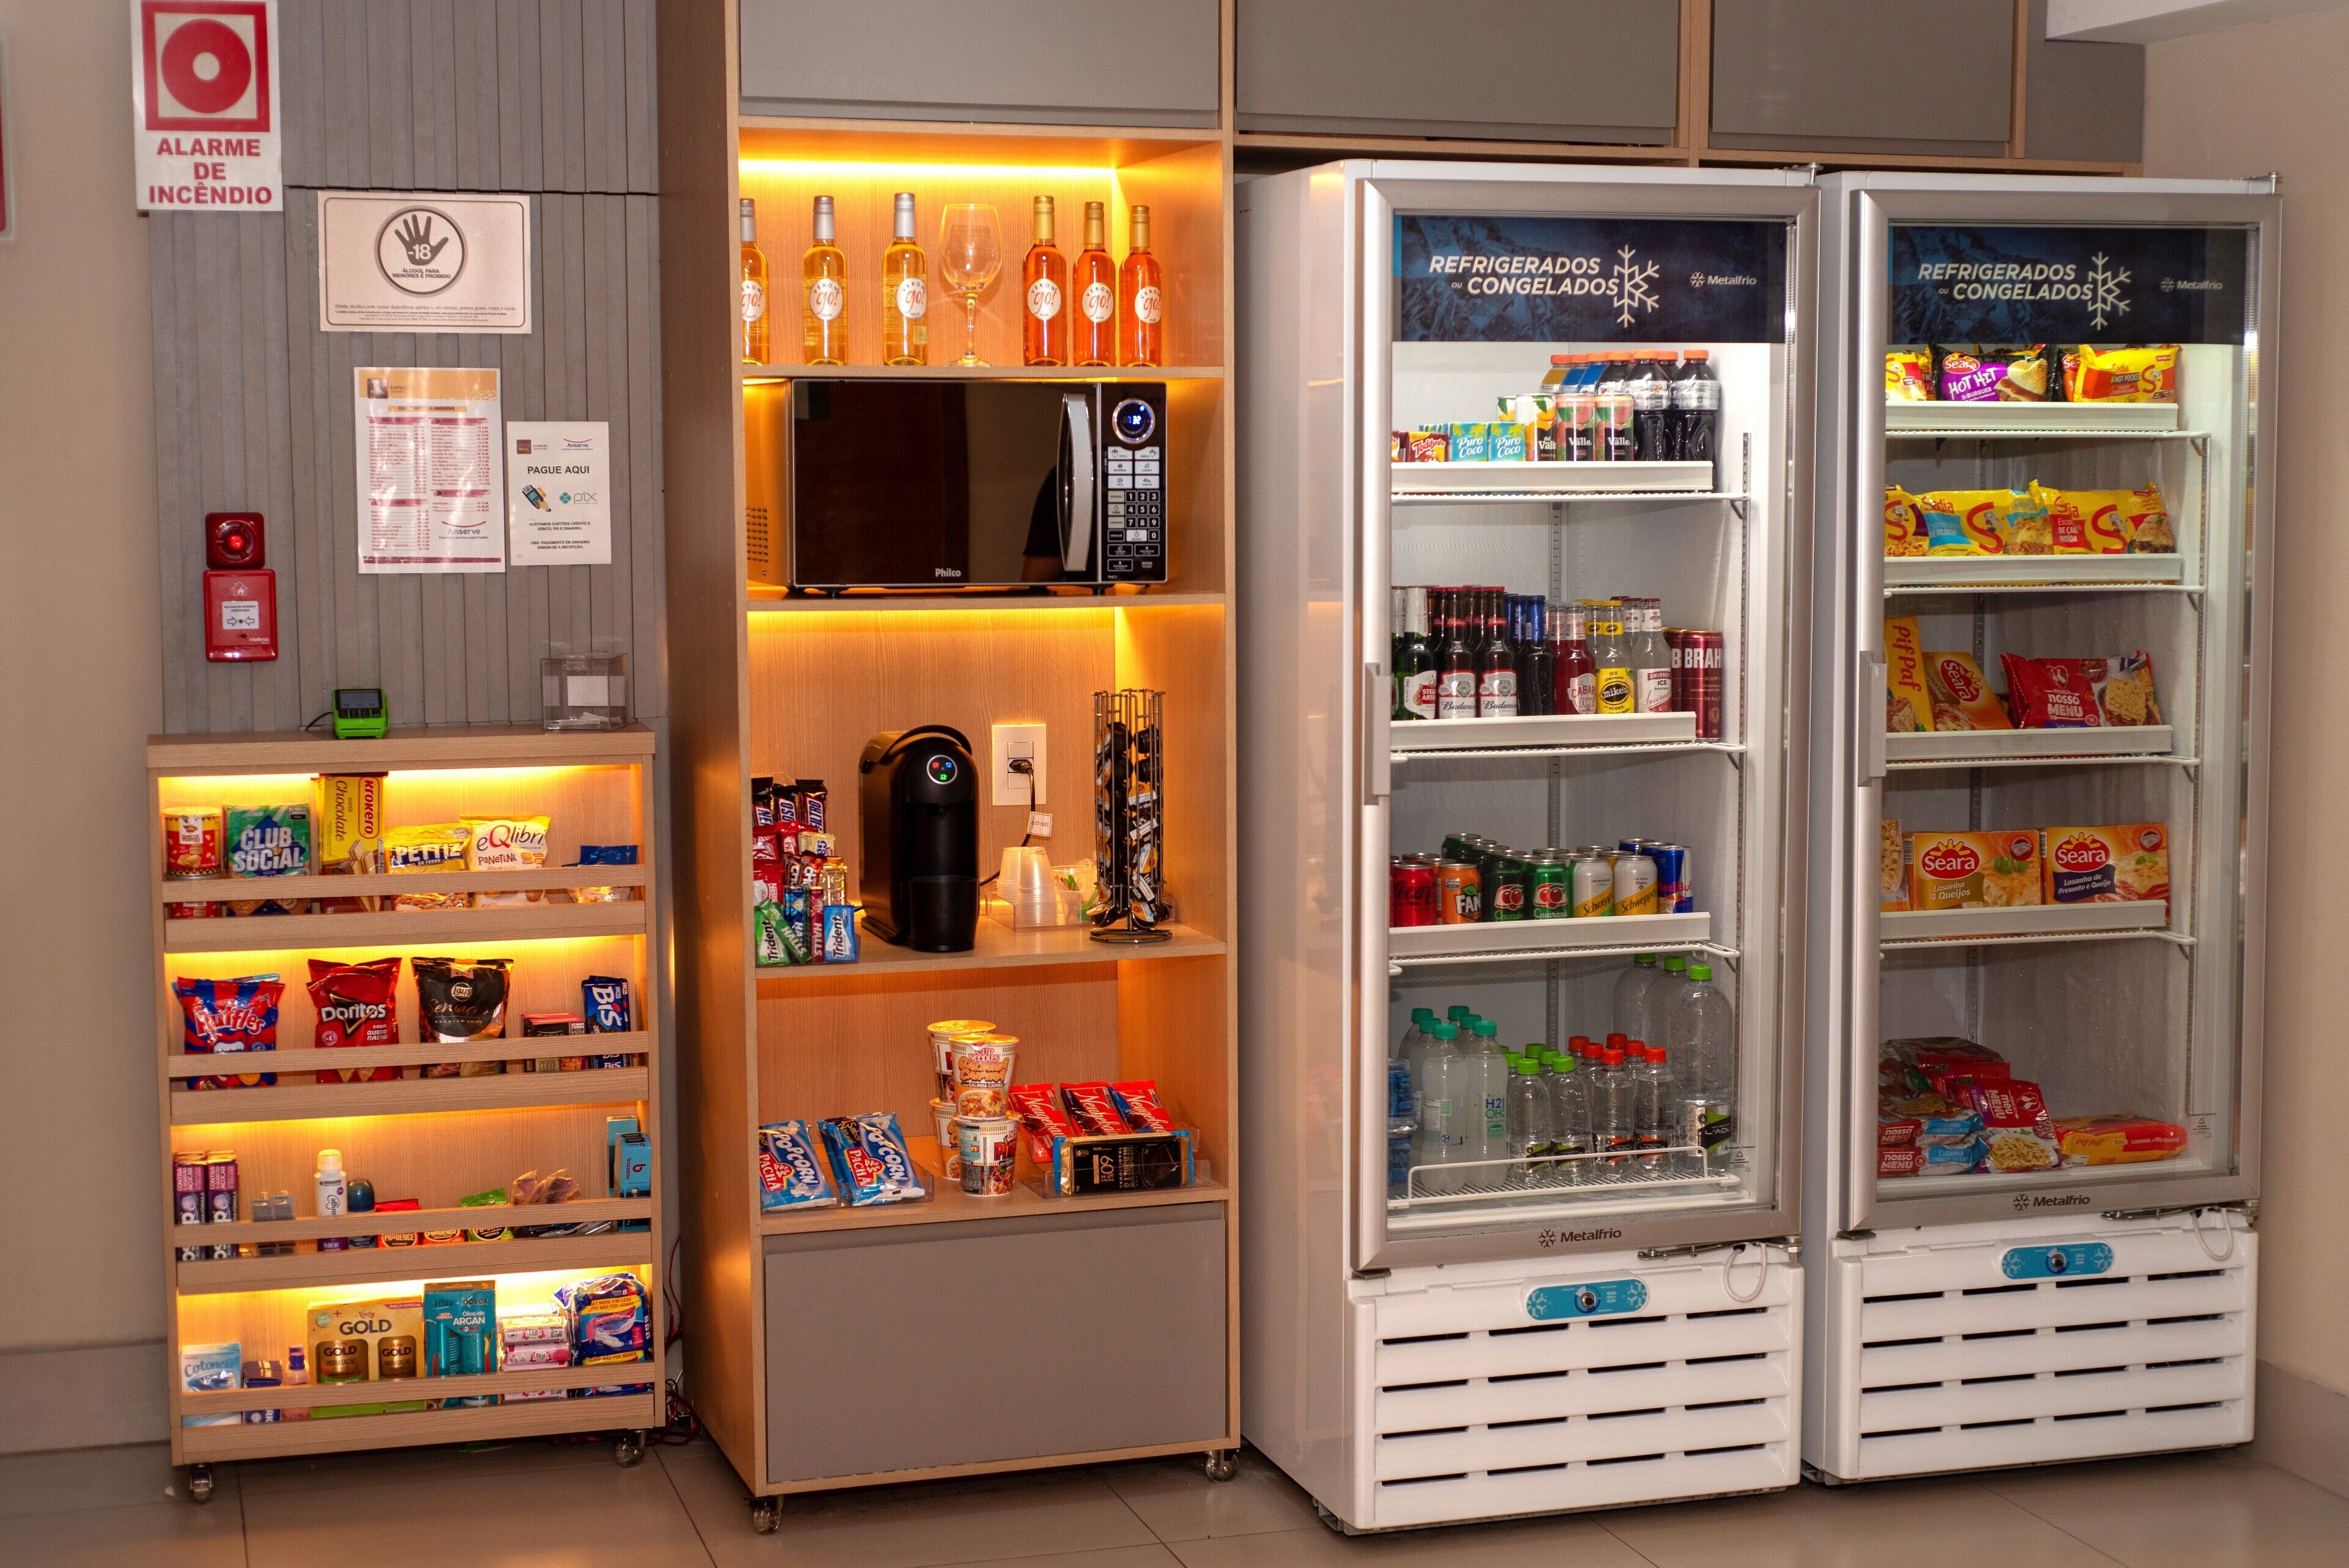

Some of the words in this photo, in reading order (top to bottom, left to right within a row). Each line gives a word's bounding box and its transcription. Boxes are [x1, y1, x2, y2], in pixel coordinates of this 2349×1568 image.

[157, 138, 261, 157] ALARME
[194, 162, 226, 180] DE
[149, 183, 272, 205] INCÊNDIO
[1428, 255, 1601, 275] REFRIGERADOS
[1918, 263, 2077, 281] REFRIGERADOS
[1452, 280, 1463, 289] OU
[1467, 276, 1619, 296] CONGELADOS
[1707, 274, 1757, 286] Metalfrio
[2176, 280, 2224, 291] Metalfrio
[1953, 283, 2093, 301] CONGELADOS
[1945, 359, 1977, 370] Seara
[2112, 363, 2129, 373] Sadia
[2124, 373, 2140, 382] POCKET
[1948, 376, 1971, 400] HOT
[1961, 387, 1992, 400] X-BURGUER
[1412, 438, 1446, 458] Toddynho
[1457, 437, 1483, 447] Puro
[1496, 437, 1521, 448] Puro
[1459, 446, 1483, 458] Coco
[1497, 445, 1521, 458] Coco
[574, 491, 597, 505] pix
[2059, 534, 2077, 543] MOÍDA
[935, 568, 961, 578] Philco
[1943, 662, 1972, 699] Seara
[1603, 685, 1628, 699] mike's
[2047, 704, 2083, 717] MENU
[335, 780, 347, 842] Chocolate
[240, 827, 292, 851] CLUB
[476, 824, 547, 852] eQlibri
[396, 842, 465, 863] PETTIZ
[2057, 849, 2106, 864] Seara
[1924, 856, 1975, 871] Seara
[1934, 882, 1965, 892] Lasanha
[2064, 876, 2092, 886] Lasanha
[1939, 888, 1971, 900] Queijos
[2058, 885, 2085, 894] Presunto
[763, 919, 779, 963] Trident
[781, 926, 807, 957] HALLS
[812, 923, 823, 956] HALLS
[833, 916, 844, 959] Trident
[320, 1003, 387, 1023] Doritos
[194, 1005, 266, 1037] Ruffles
[968, 1053, 1000, 1063] NOODLES
[976, 1049, 995, 1057] CUP
[1486, 1098, 1502, 1109] H2
[1989, 1090, 2006, 1120] MENU
[773, 1134, 819, 1184] POPCORN
[1881, 1161, 1913, 1170] MENU
[849, 1150, 869, 1186] PACHÁ
[2033, 1195, 2090, 1207] Metalfrio
[1560, 1228, 1622, 1243] Metalfrio
[453, 1317, 485, 1326] ARGAN
[596, 1314, 631, 1323] Naturalmente
[338, 1320, 393, 1336] GOLD
[324, 1345, 357, 1357] GOLD
[382, 1347, 412, 1357] GOLD
